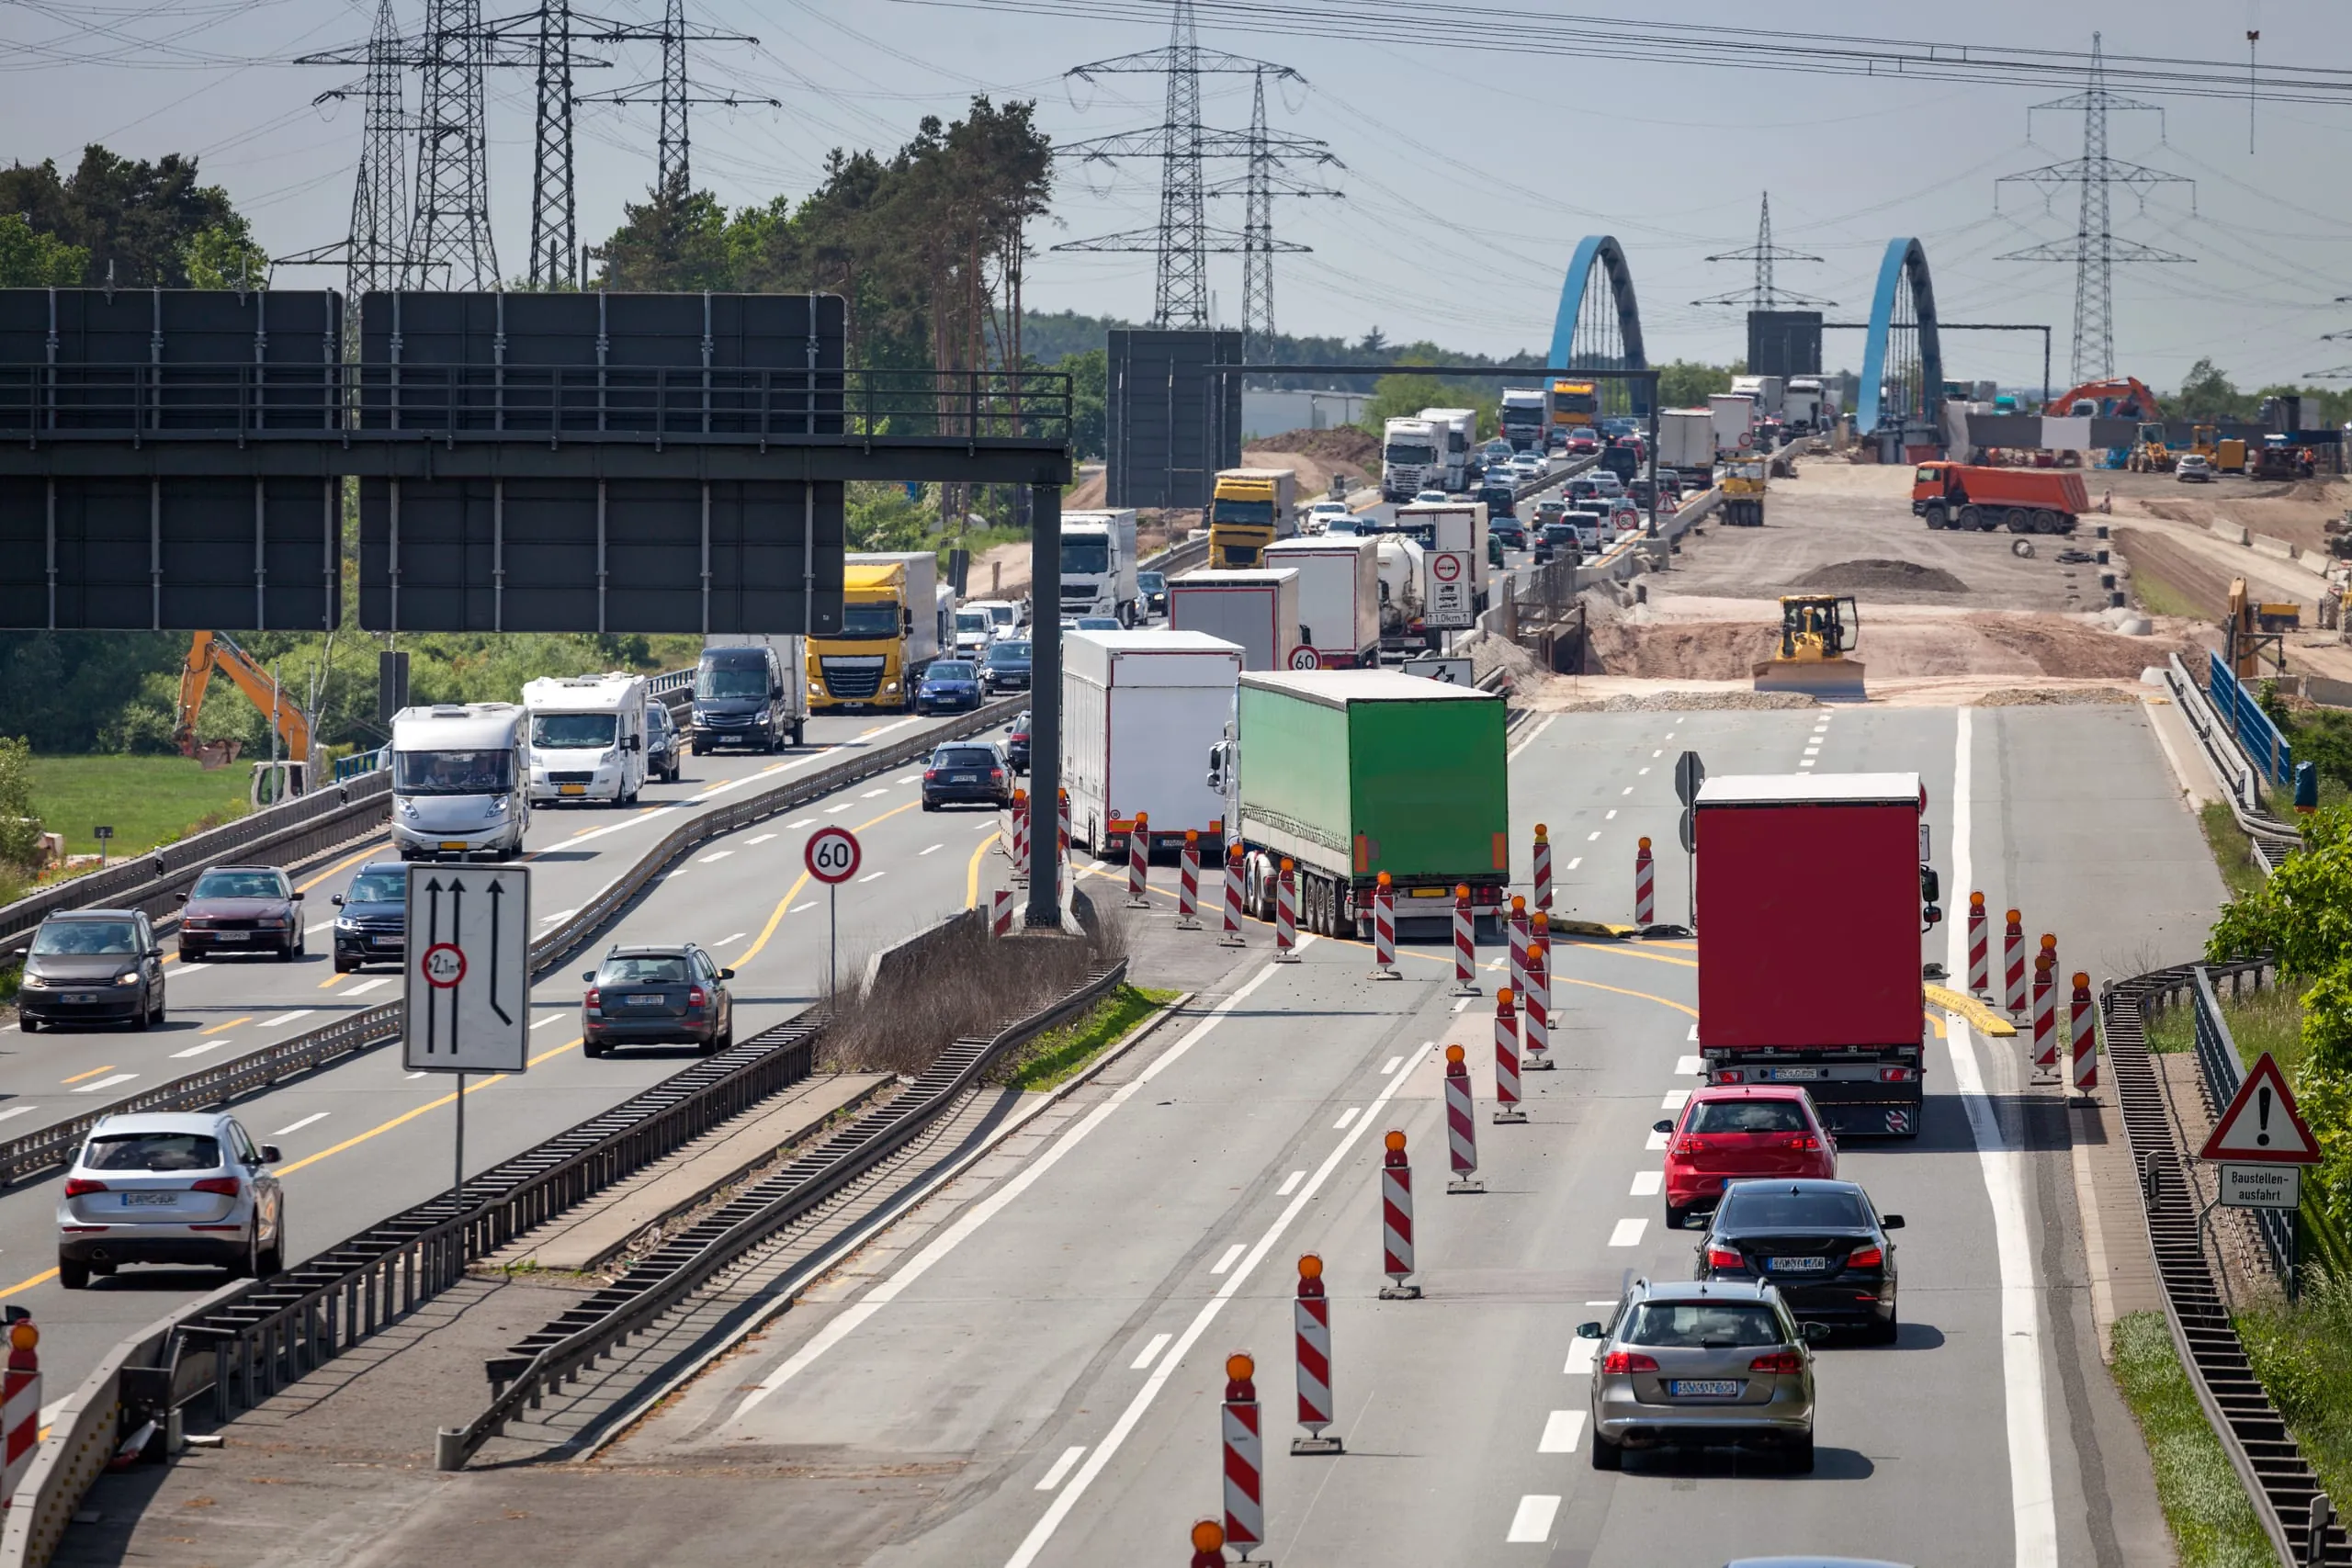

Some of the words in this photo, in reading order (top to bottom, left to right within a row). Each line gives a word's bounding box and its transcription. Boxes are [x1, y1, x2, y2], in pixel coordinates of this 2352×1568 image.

[1295, 654, 1315, 671] 60
[818, 843, 849, 868] 60
[2232, 1171, 2290, 1186] Baustellen-
[2239, 1189, 2280, 1201] ausfahrt
